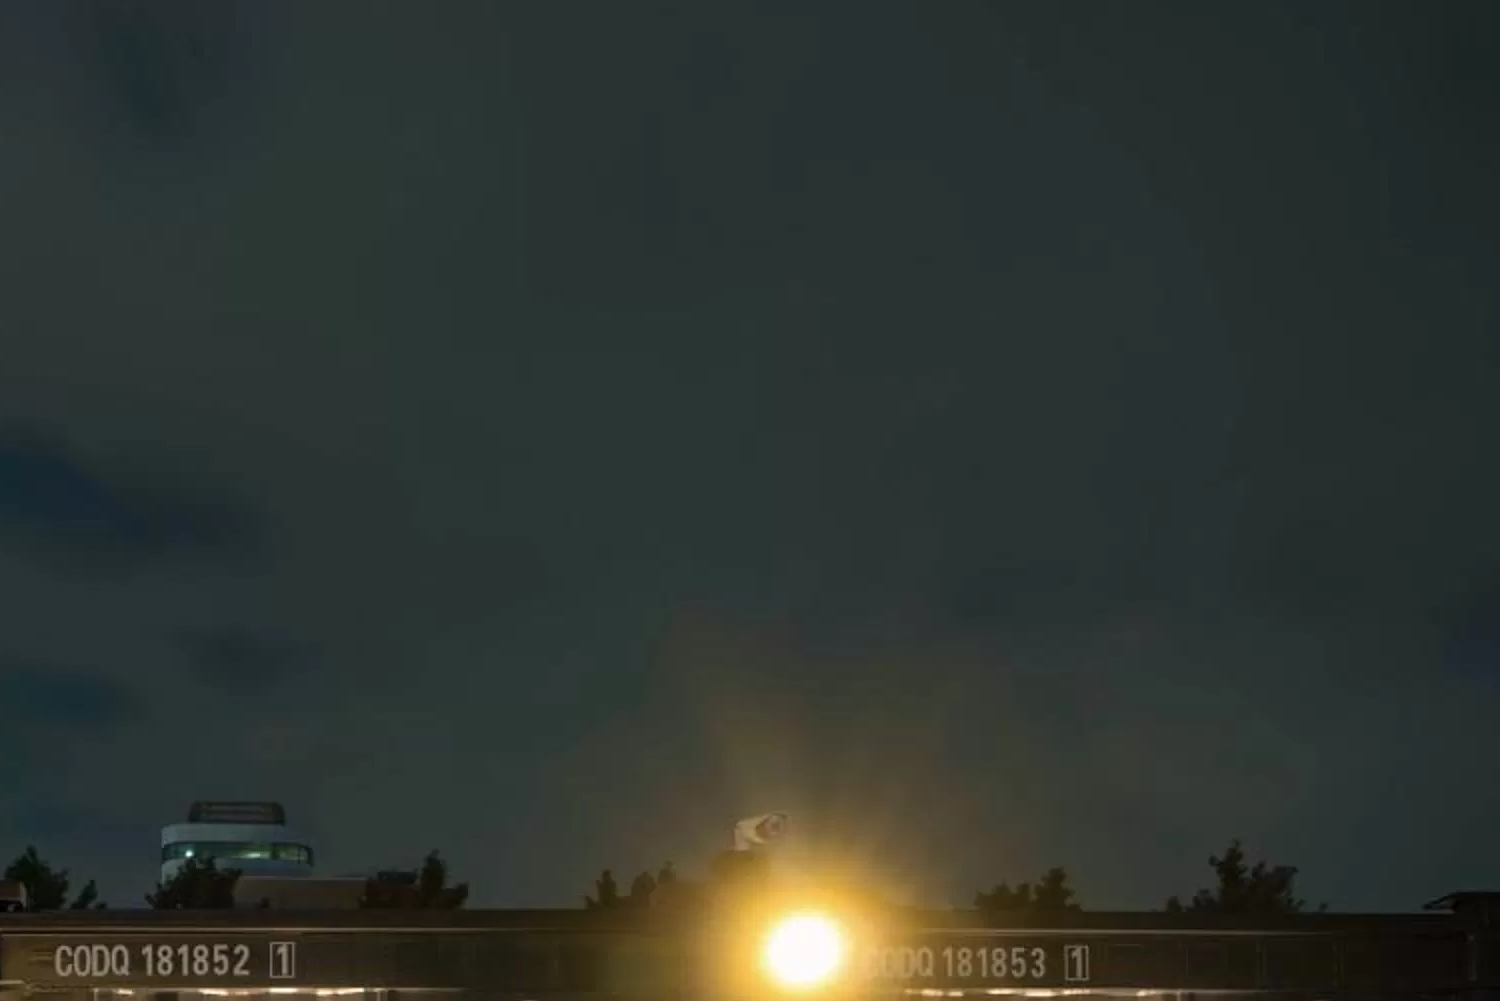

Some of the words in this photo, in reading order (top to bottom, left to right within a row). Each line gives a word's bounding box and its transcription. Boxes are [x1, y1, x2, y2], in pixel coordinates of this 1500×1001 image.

[55, 944, 130, 977] CODQ
[141, 943, 250, 976] 181852
[868, 945, 934, 978] ODQ
[942, 946, 1046, 978] 181853
